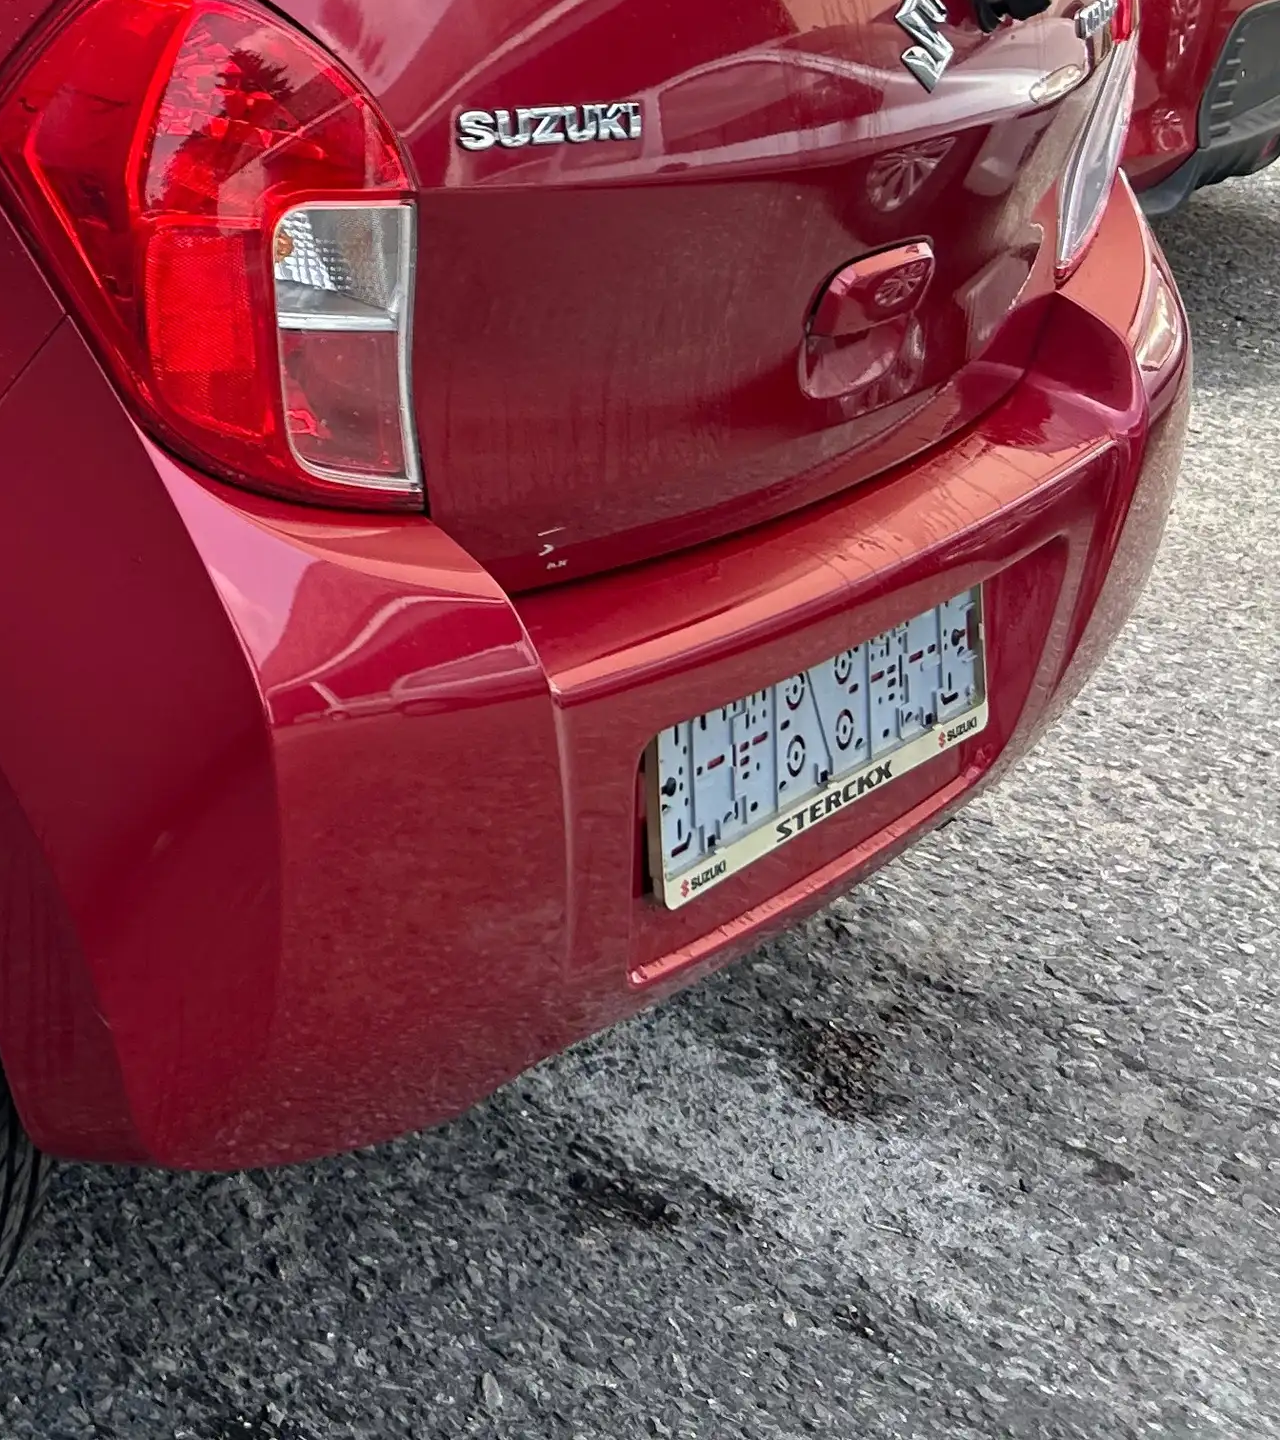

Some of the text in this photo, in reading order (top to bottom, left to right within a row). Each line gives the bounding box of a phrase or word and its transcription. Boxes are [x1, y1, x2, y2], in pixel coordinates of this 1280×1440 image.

[458, 102, 642, 151] SUZUKI
[947, 715, 978, 742] SUZUKI
[775, 760, 893, 843] STERCKX
[690, 859, 727, 891] SUZUKI
